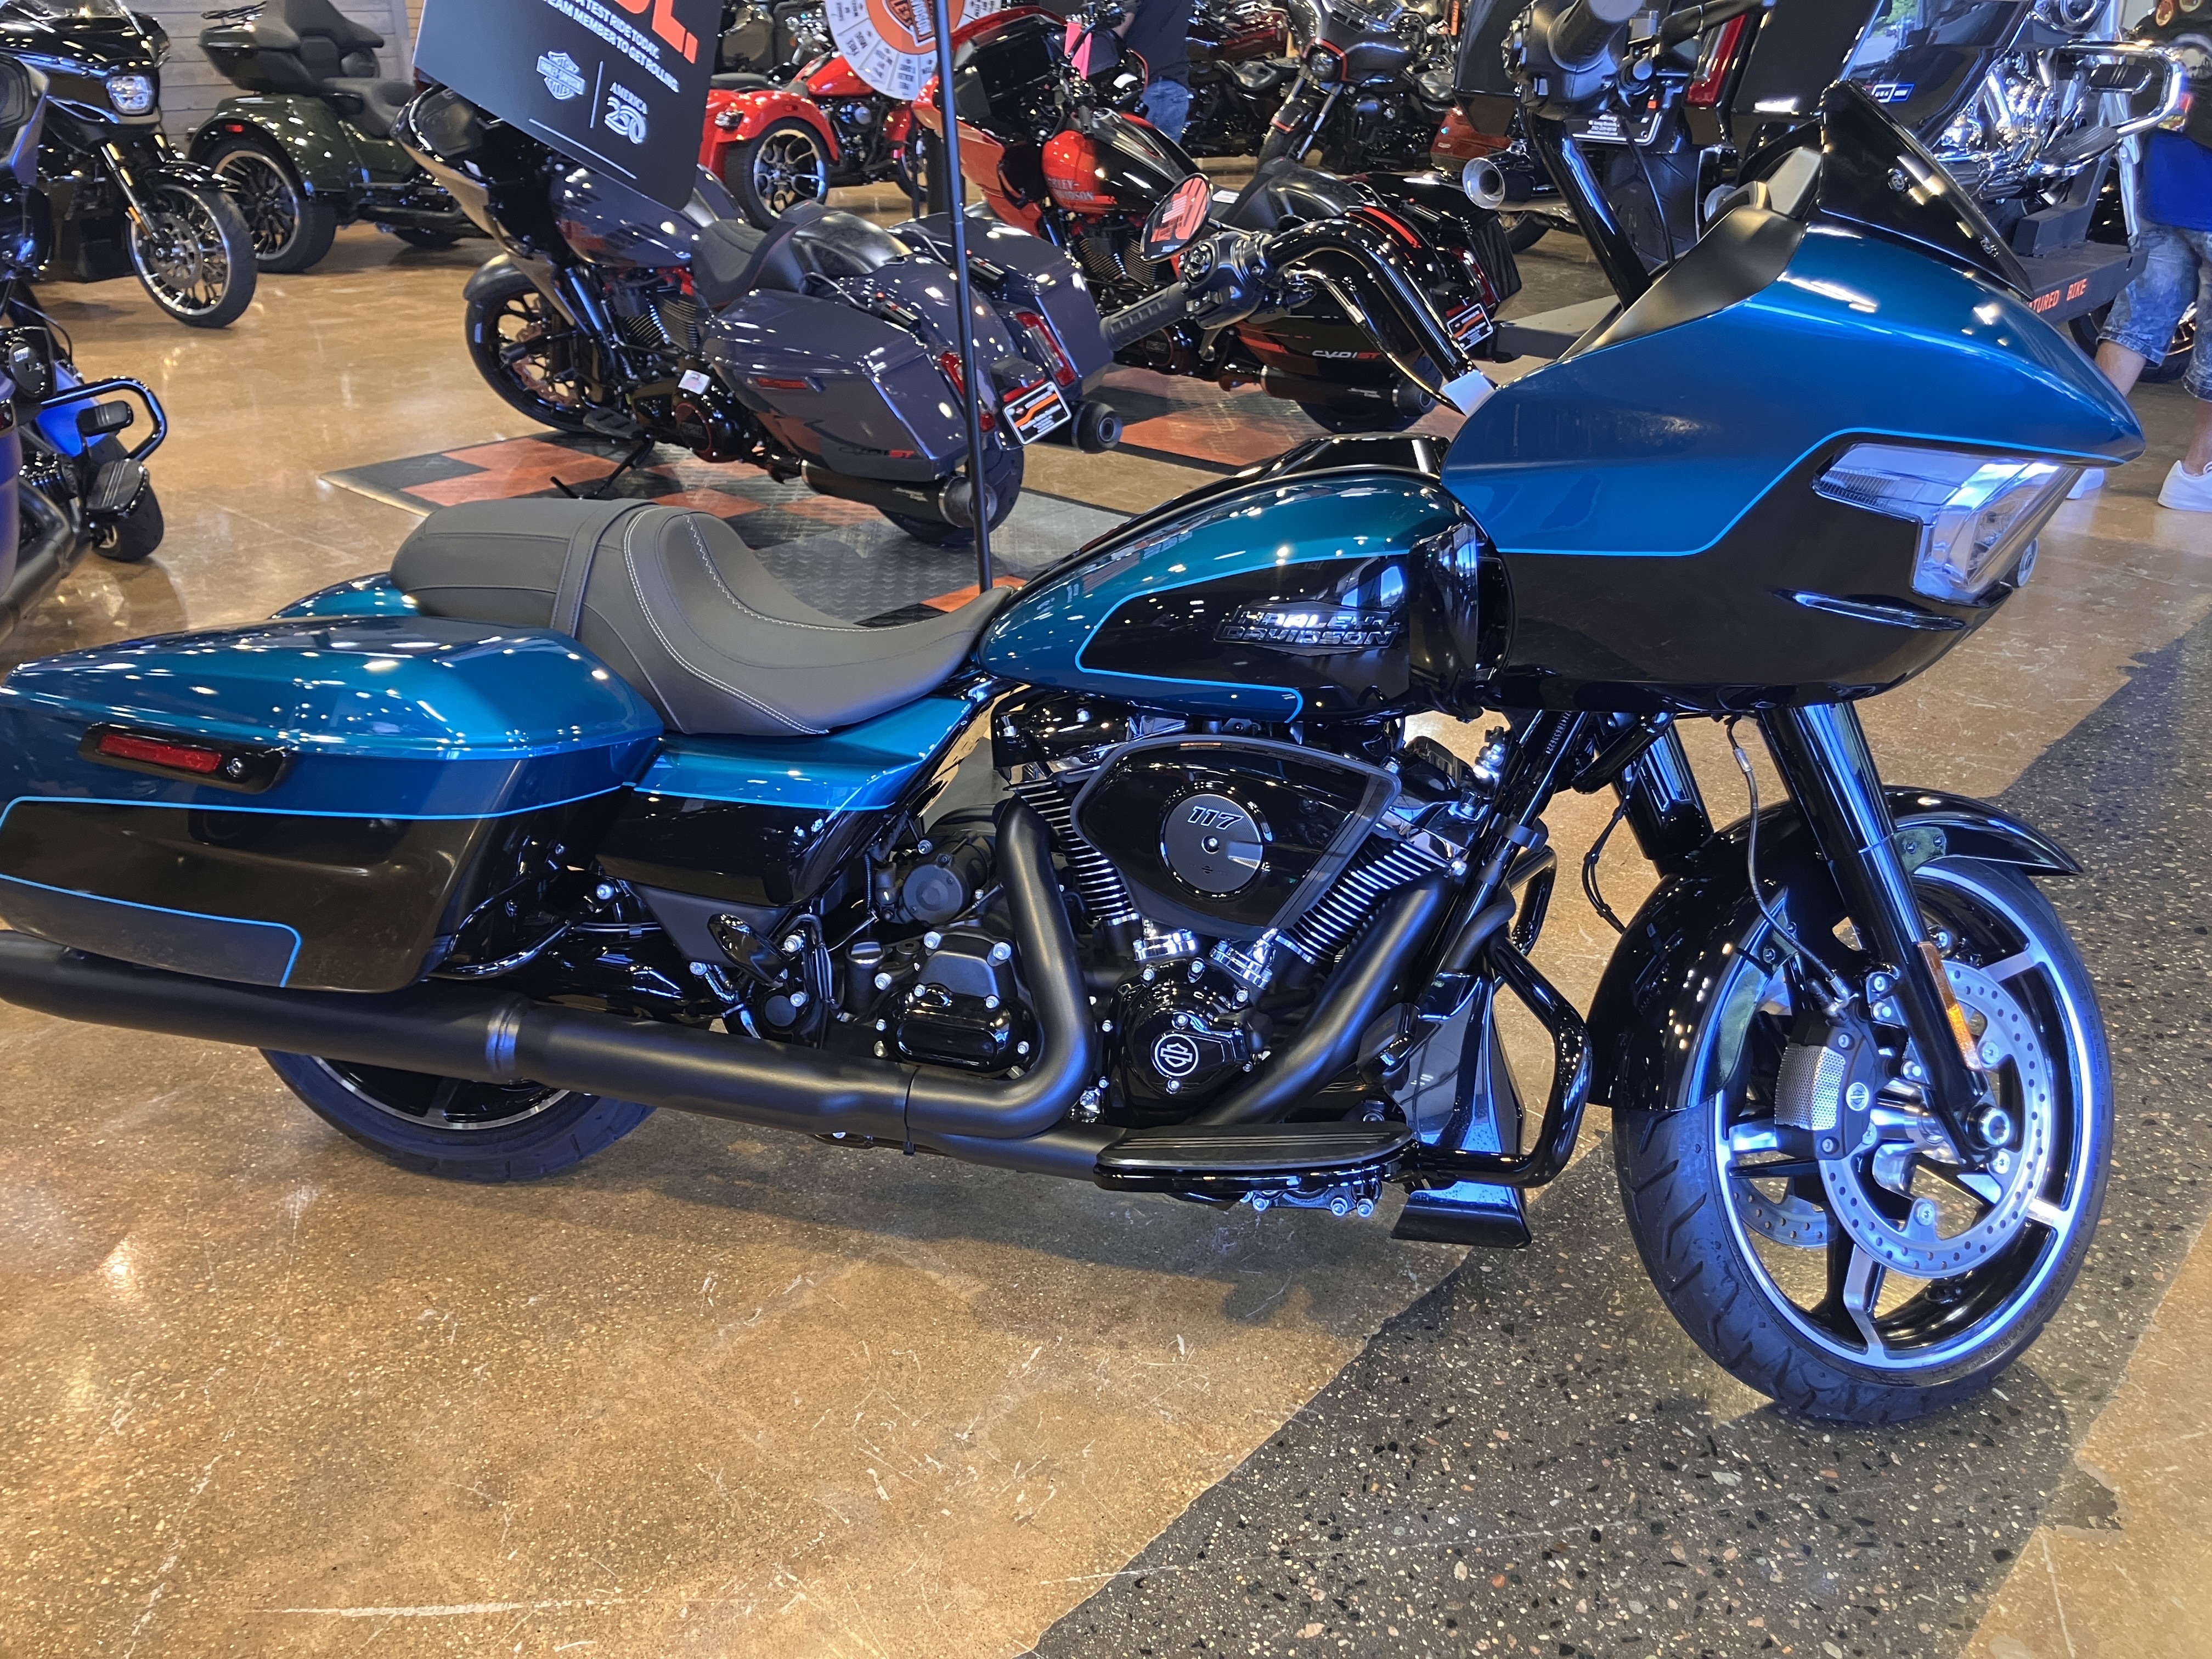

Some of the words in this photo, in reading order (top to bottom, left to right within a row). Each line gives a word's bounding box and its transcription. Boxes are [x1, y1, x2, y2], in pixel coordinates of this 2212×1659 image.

[544, 0, 573, 17] EAM
[573, 8, 617, 46] MEMBER
[616, 36, 630, 53] TO
[629, 46, 647, 66] GET
[585, 0, 612, 22] TEST
[610, 14, 633, 38] RIDE
[911, 0, 932, 35] VIDSON
[609, 82, 647, 115] AMERICA
[604, 97, 646, 144] 250
[2028, 290, 2060, 313] TURED
[2066, 278, 2088, 301] BIKE
[1220, 626, 1392, 645] DAVIDSON
[1187, 805, 1245, 831] 117
